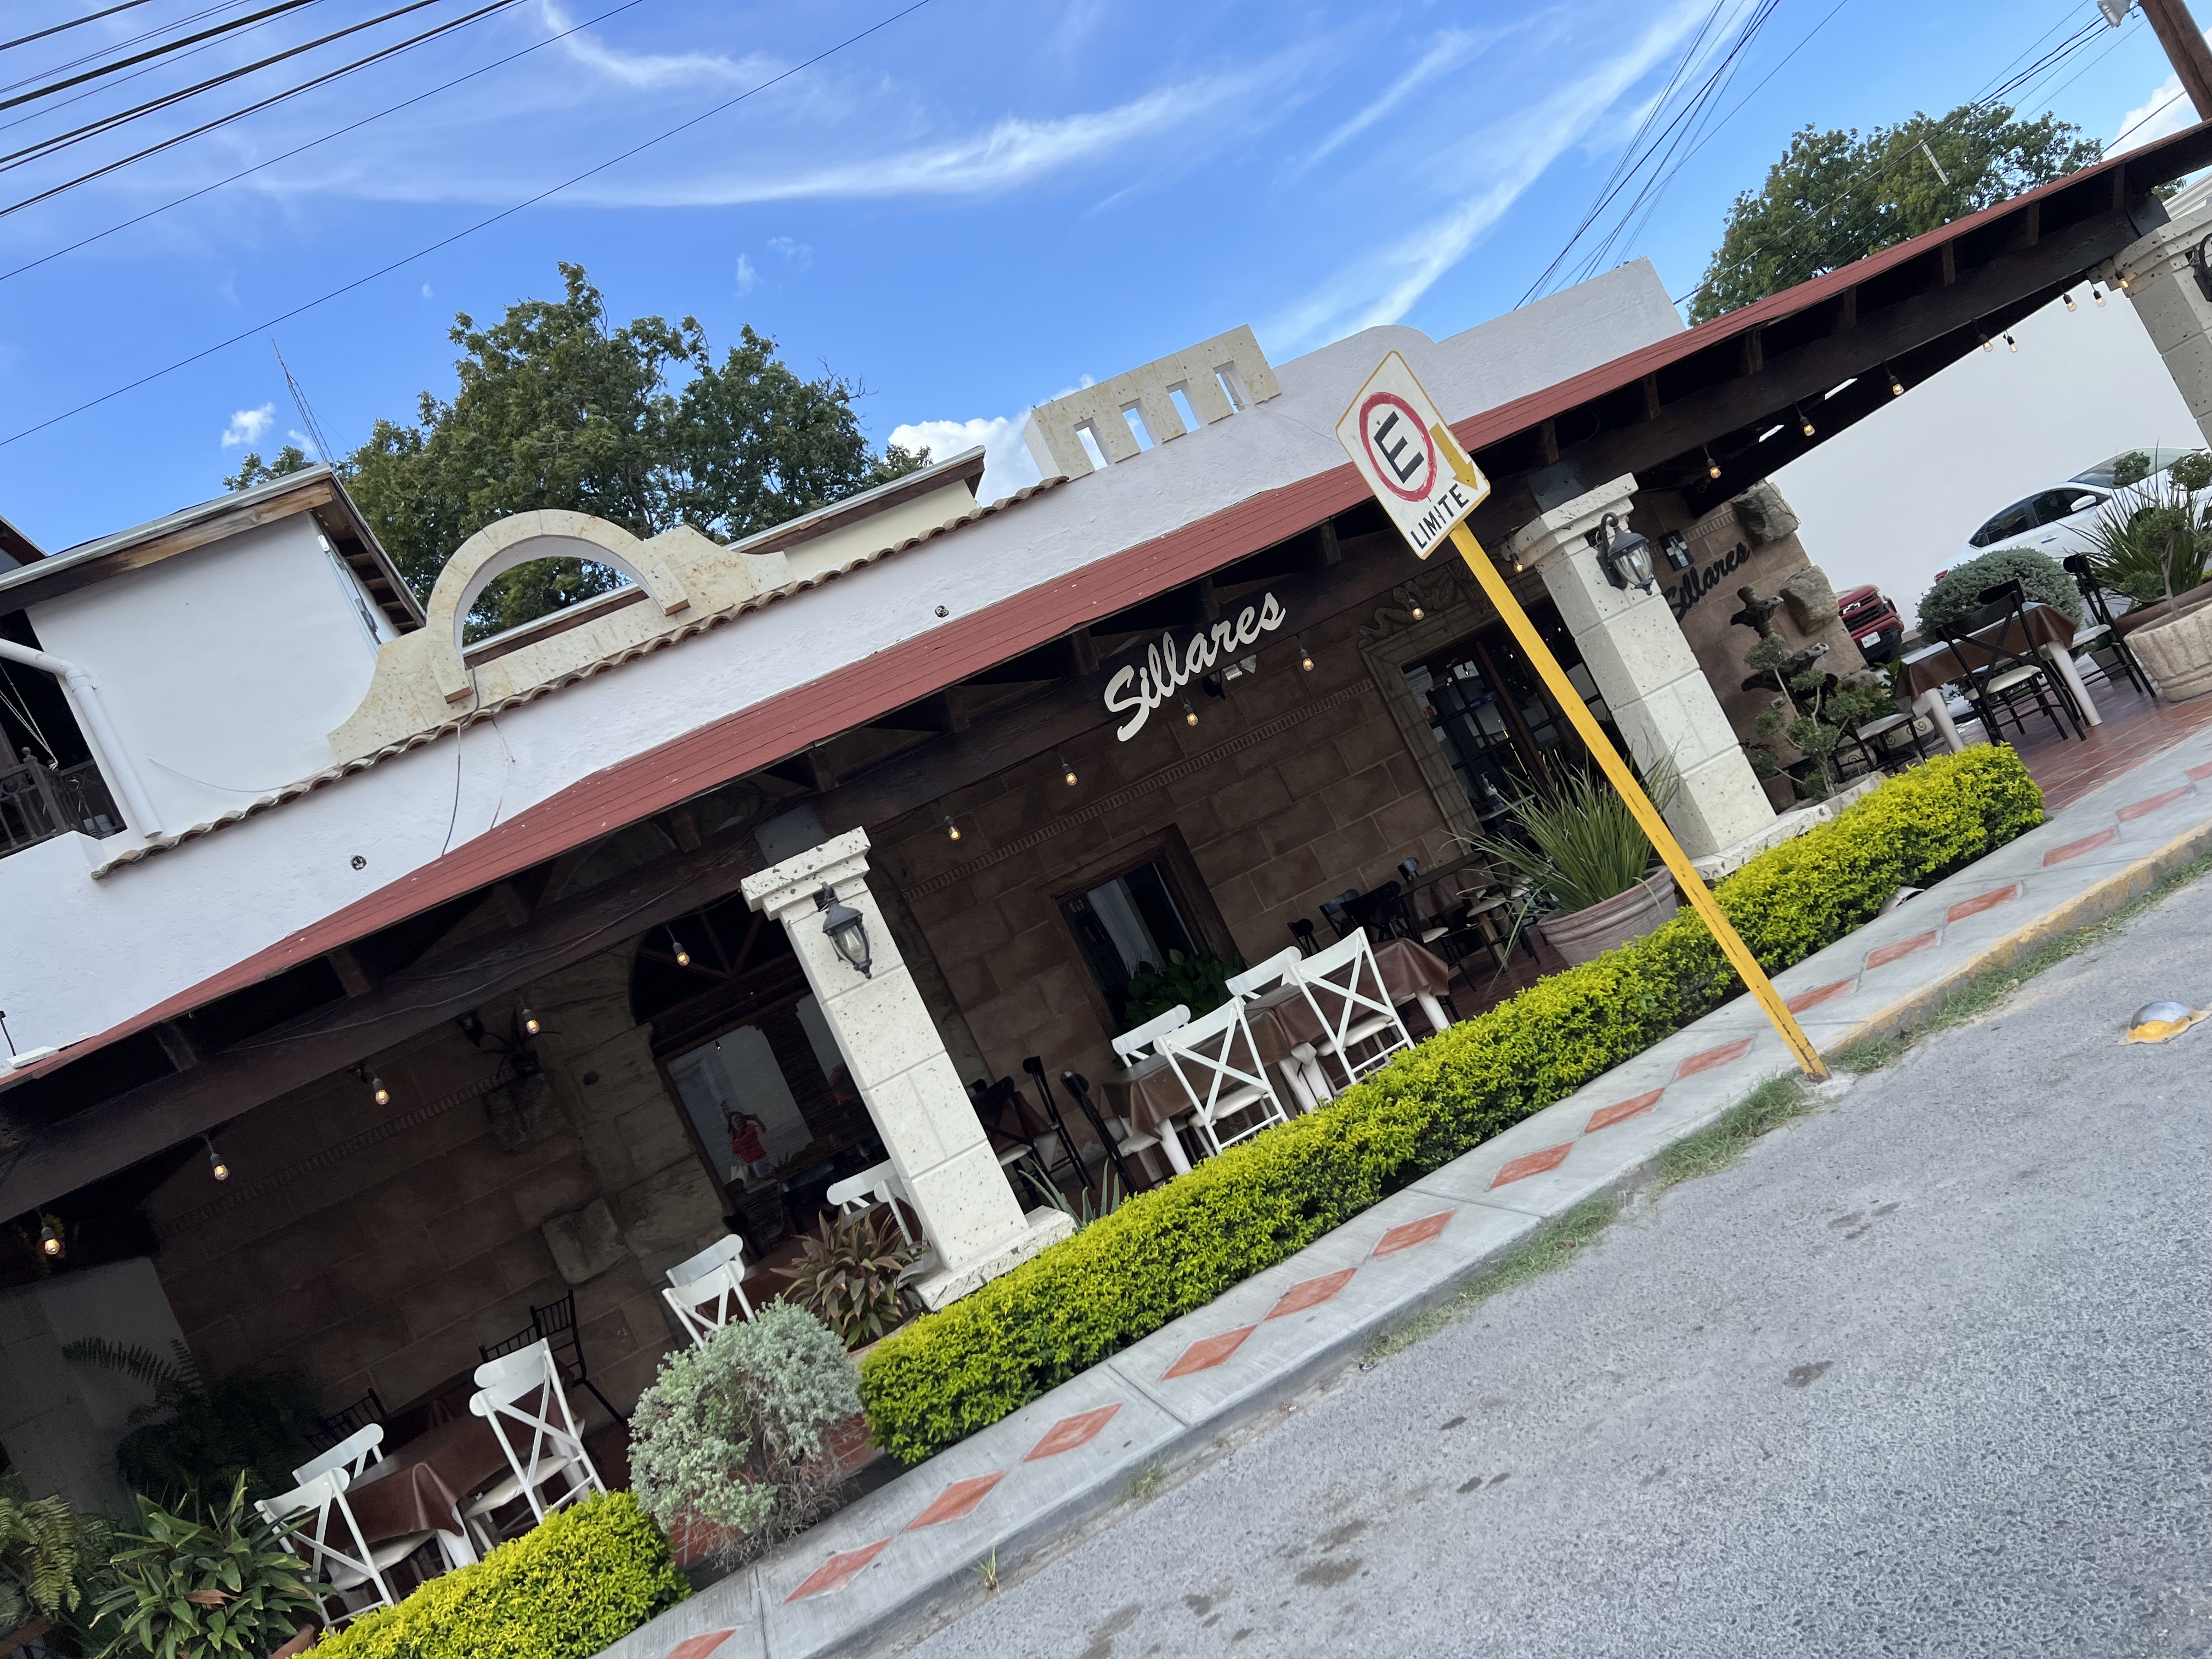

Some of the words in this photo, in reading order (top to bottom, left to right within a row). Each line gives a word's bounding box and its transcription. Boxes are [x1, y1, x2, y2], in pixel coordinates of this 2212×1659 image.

[1374, 411, 1424, 484] E
[1410, 483, 1469, 549] LIMITE
[1104, 592, 1286, 742] Sillares
